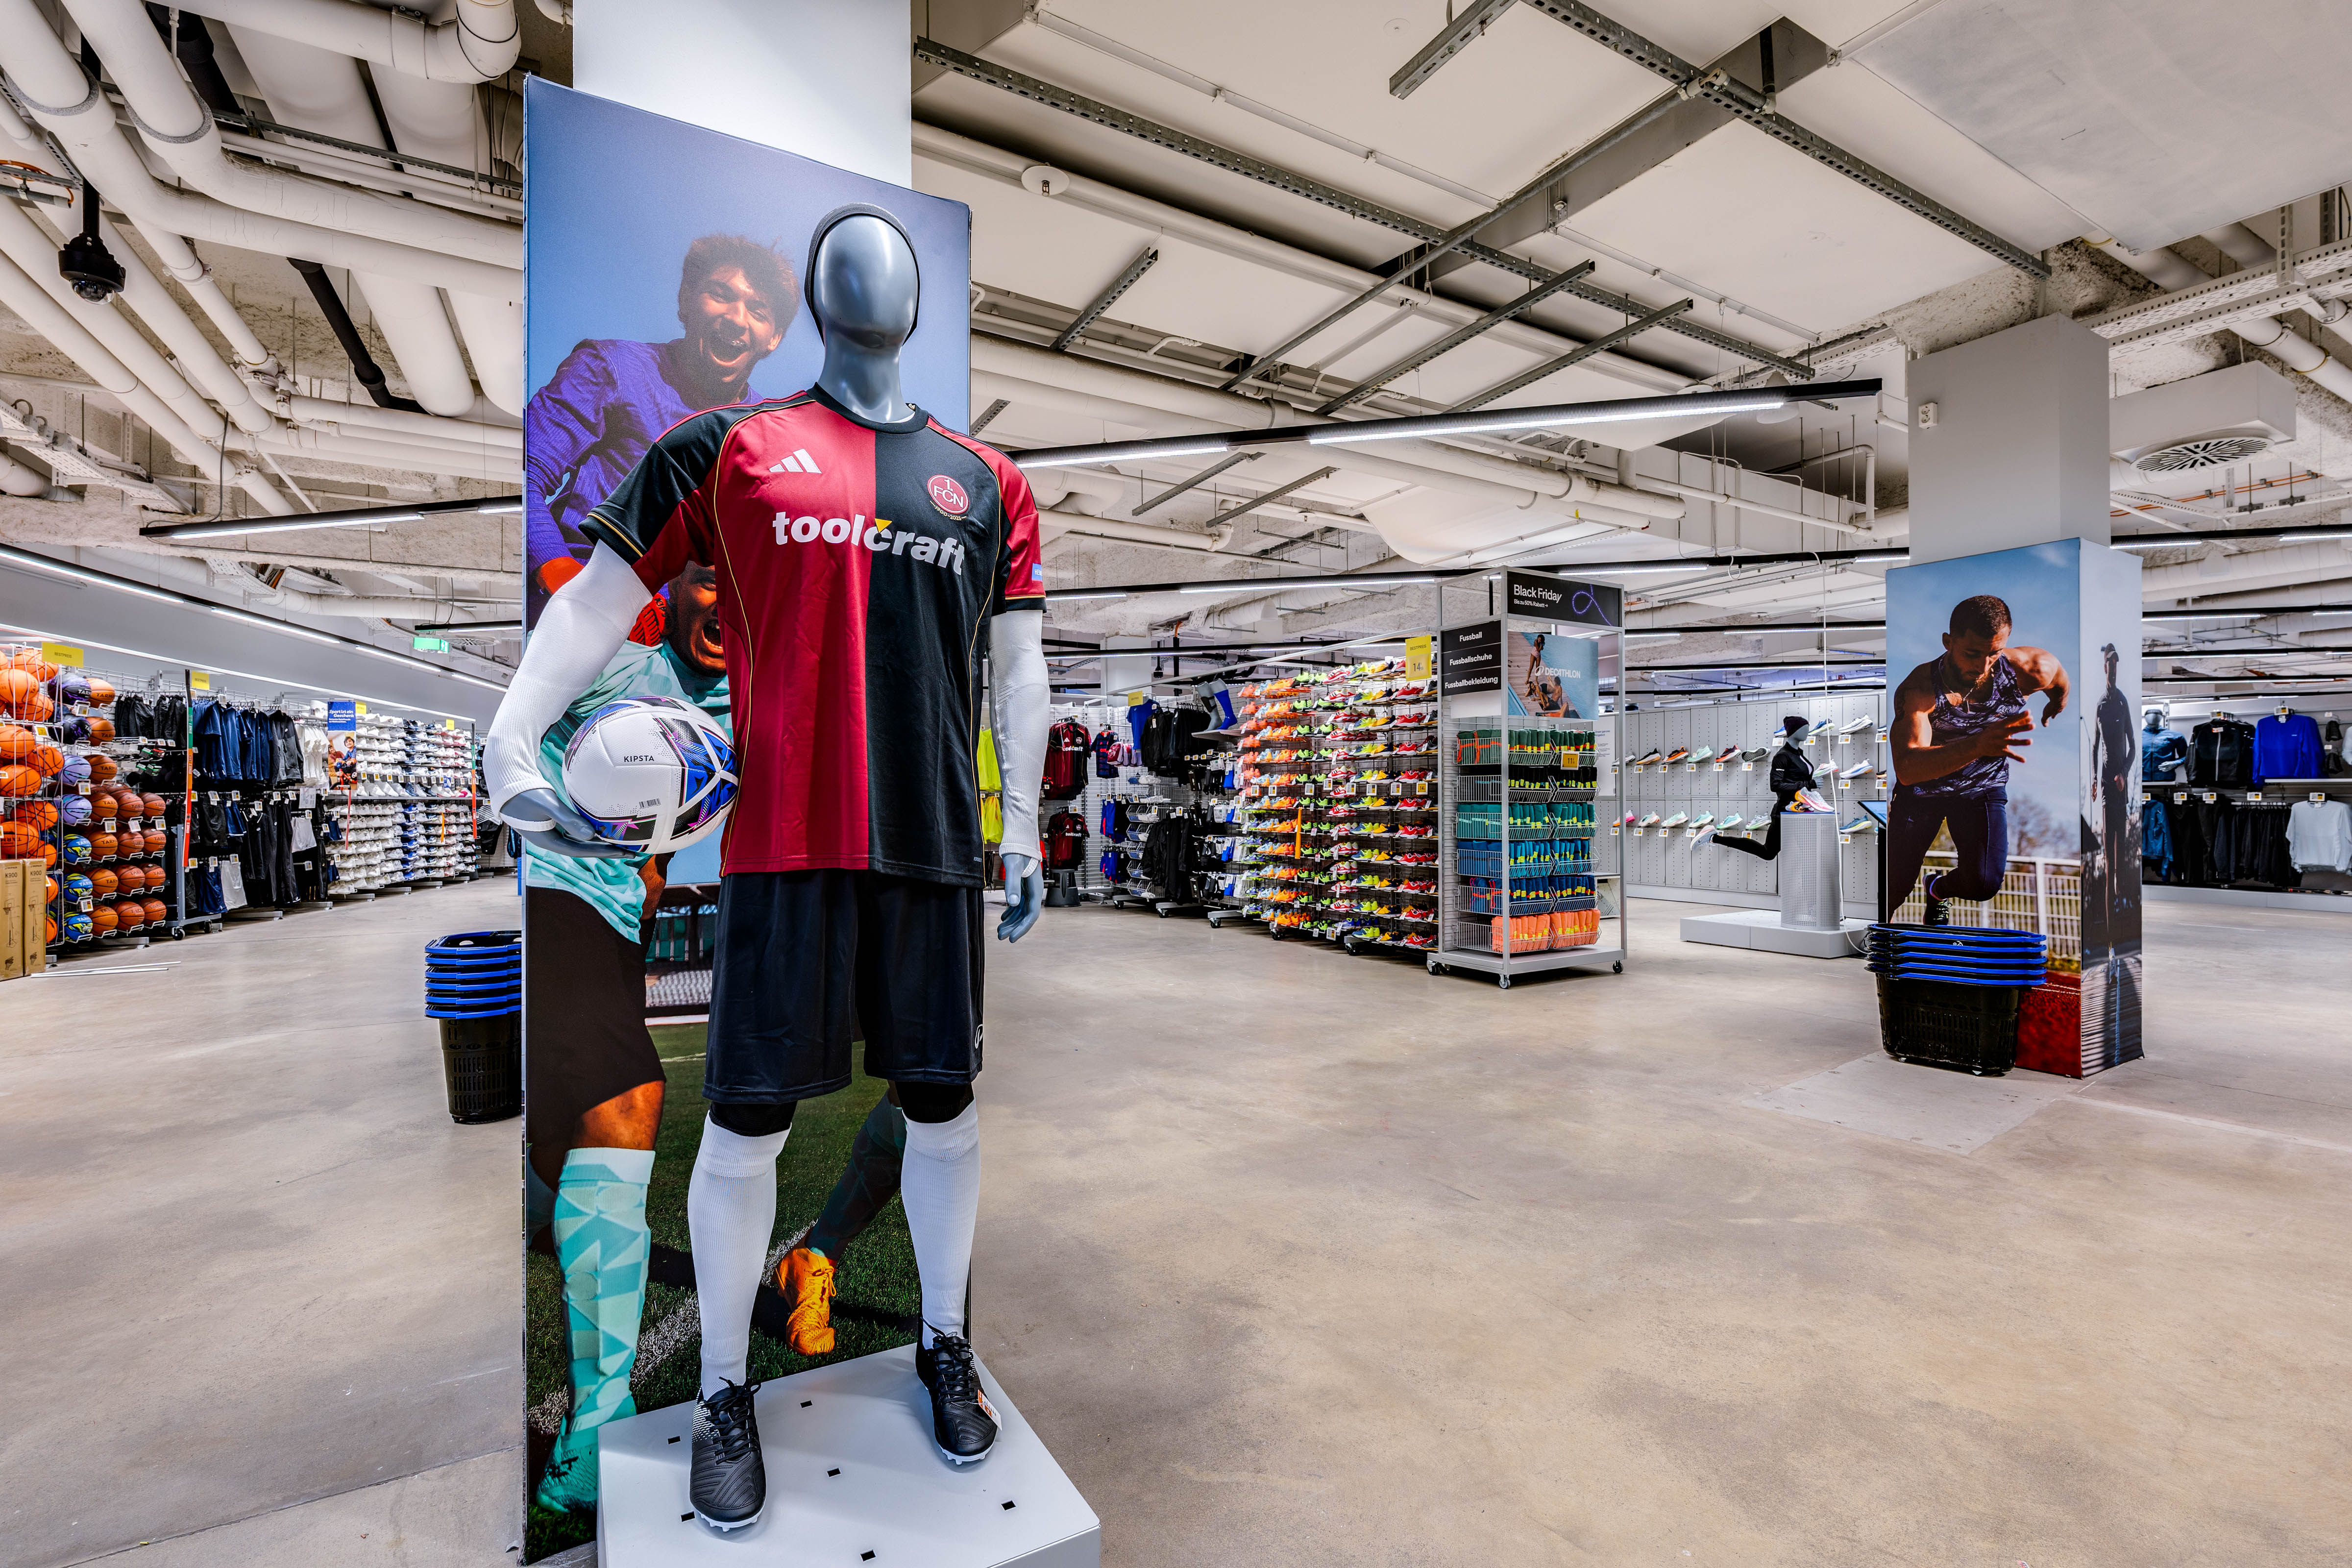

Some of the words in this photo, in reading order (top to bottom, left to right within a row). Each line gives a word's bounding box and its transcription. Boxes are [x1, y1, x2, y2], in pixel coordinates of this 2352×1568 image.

[933, 485, 964, 508] FCN
[772, 511, 965, 576] toolcraft
[1513, 584, 1537, 598] Black
[1538, 588, 1563, 604] Friday
[1459, 631, 1483, 642] Fussball
[1449, 653, 1493, 666] Fussballschuhe
[1544, 667, 1581, 679] DECATHLON
[1445, 676, 1498, 689] Fussballbekleidung
